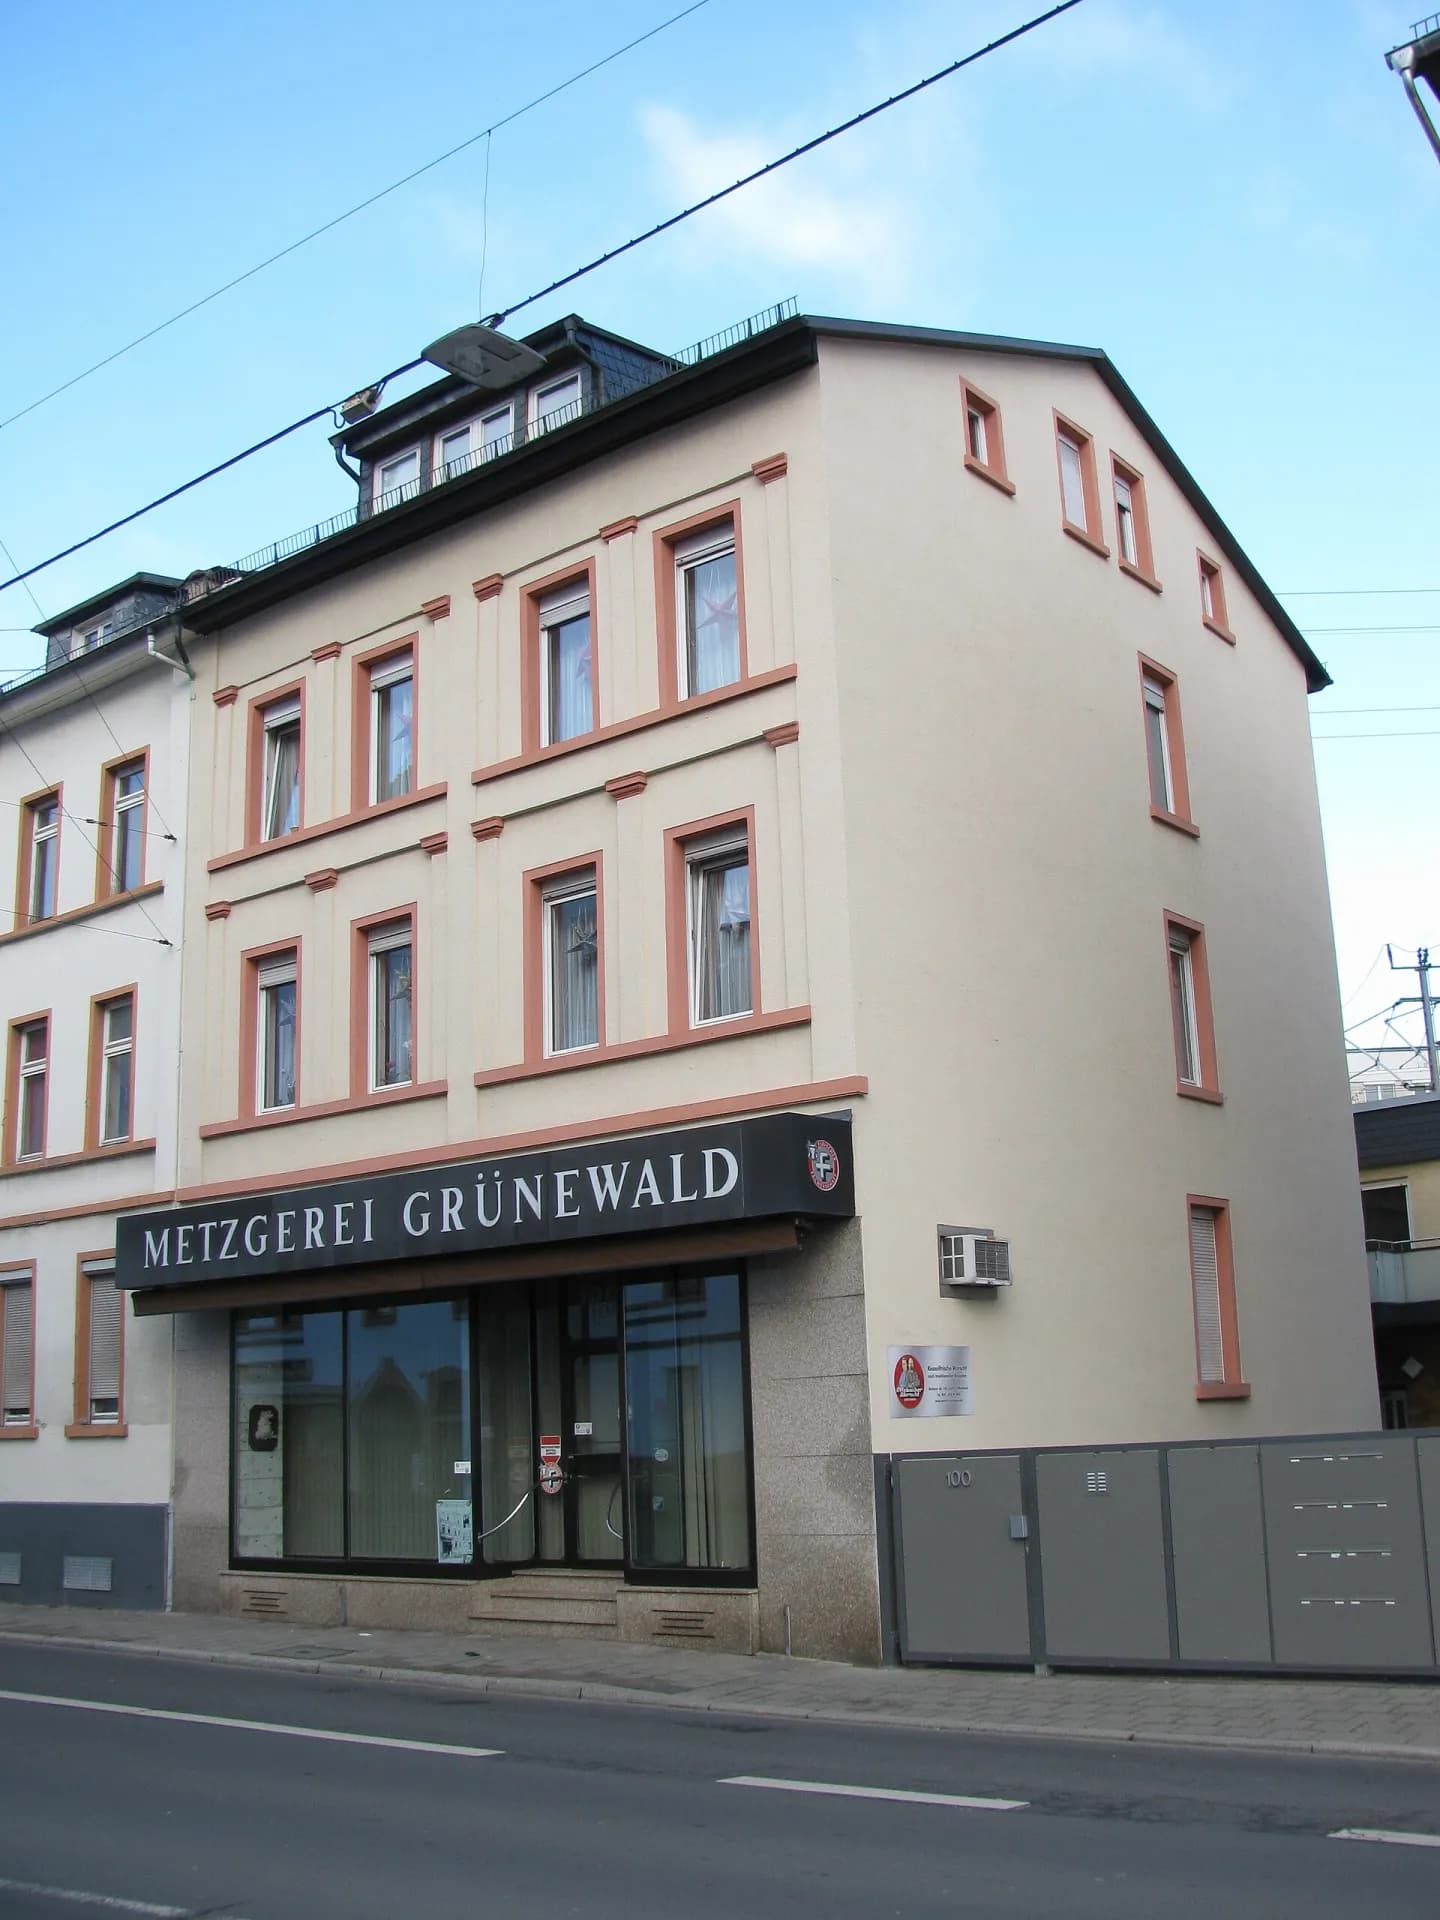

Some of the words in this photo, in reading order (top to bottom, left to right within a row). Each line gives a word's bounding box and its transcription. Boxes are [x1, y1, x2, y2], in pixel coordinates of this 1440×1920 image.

[143, 1198, 375, 1269] METZGEREI
[402, 1147, 739, 1237] GRÜNEWALD
[946, 1470, 971, 1487] 100
